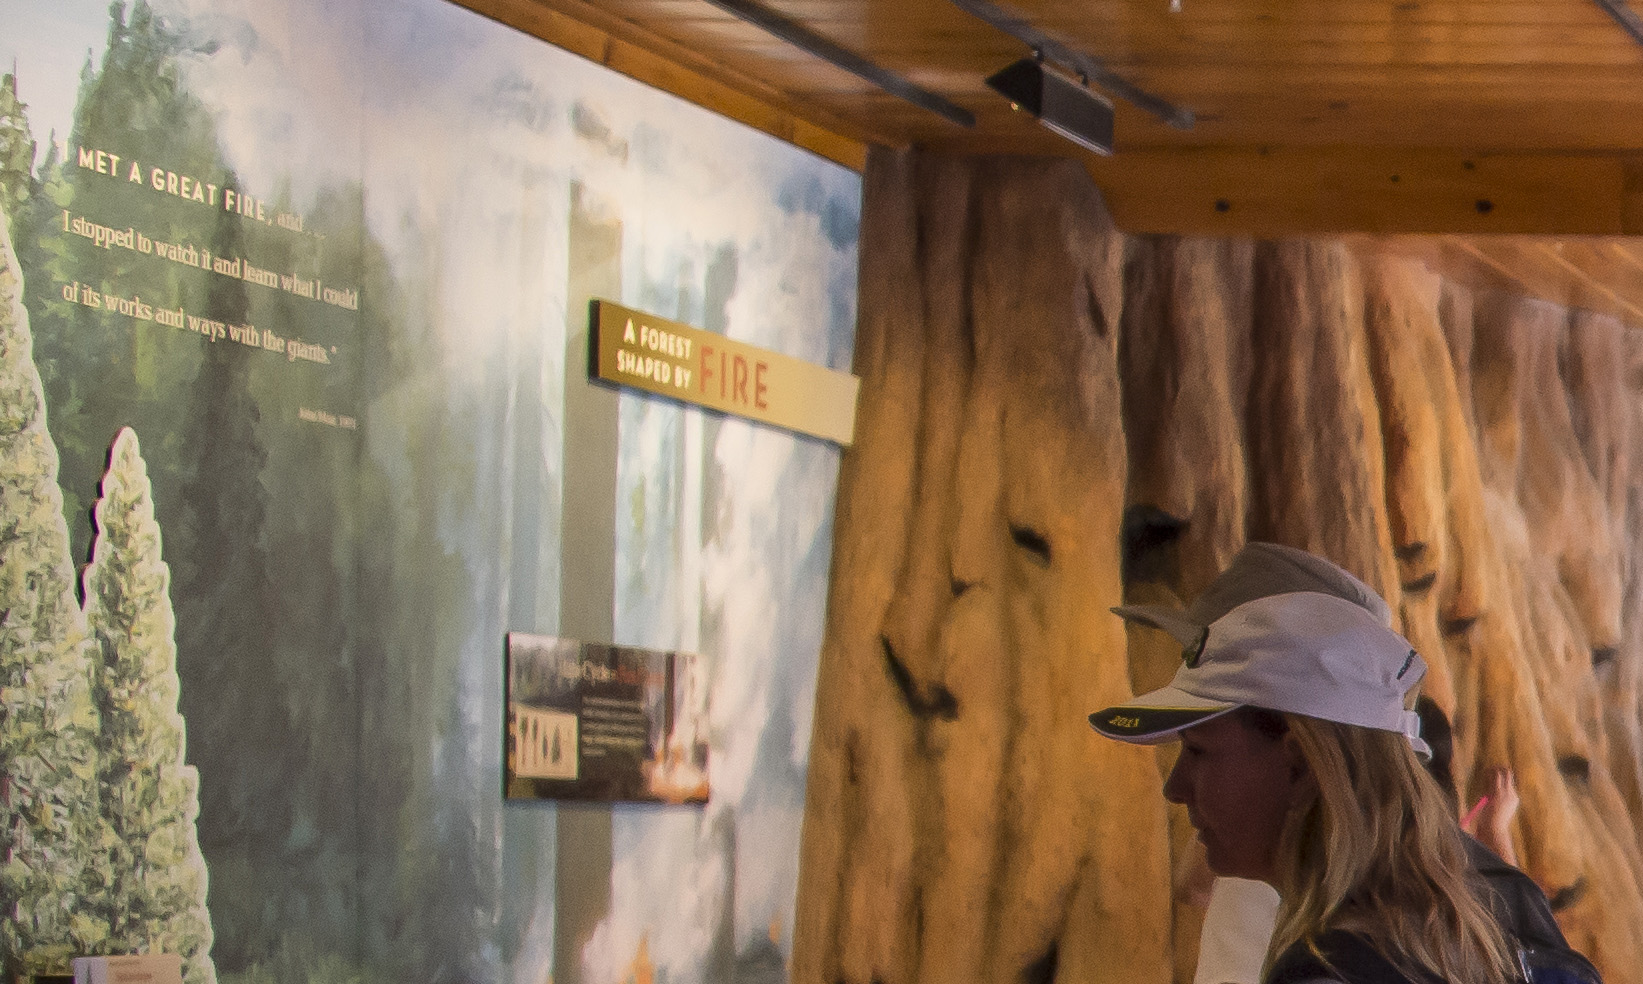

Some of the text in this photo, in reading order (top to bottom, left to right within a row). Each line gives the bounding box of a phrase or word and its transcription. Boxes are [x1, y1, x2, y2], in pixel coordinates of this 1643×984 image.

[77, 145, 121, 177] MET
[127, 161, 143, 185] A
[150, 167, 218, 206] GREAT
[224, 188, 272, 227] FIRE,
[62, 209, 71, 232] I
[70, 216, 135, 249] stopped
[136, 230, 152, 254] to
[153, 240, 200, 268] watch
[200, 248, 212, 271] it
[213, 256, 241, 279] and
[242, 258, 278, 289] learn
[281, 271, 315, 299] what
[323, 286, 358, 311] could
[62, 281, 80, 303] of
[80, 283, 101, 309] its
[104, 296, 152, 321] works
[154, 307, 185, 330] and
[186, 314, 226, 343] ways
[227, 322, 261, 348] with
[261, 328, 285, 354] the
[622, 317, 693, 361] A FOREST
[616, 348, 692, 390] SHAPED BY
[699, 344, 770, 411] FIRE
